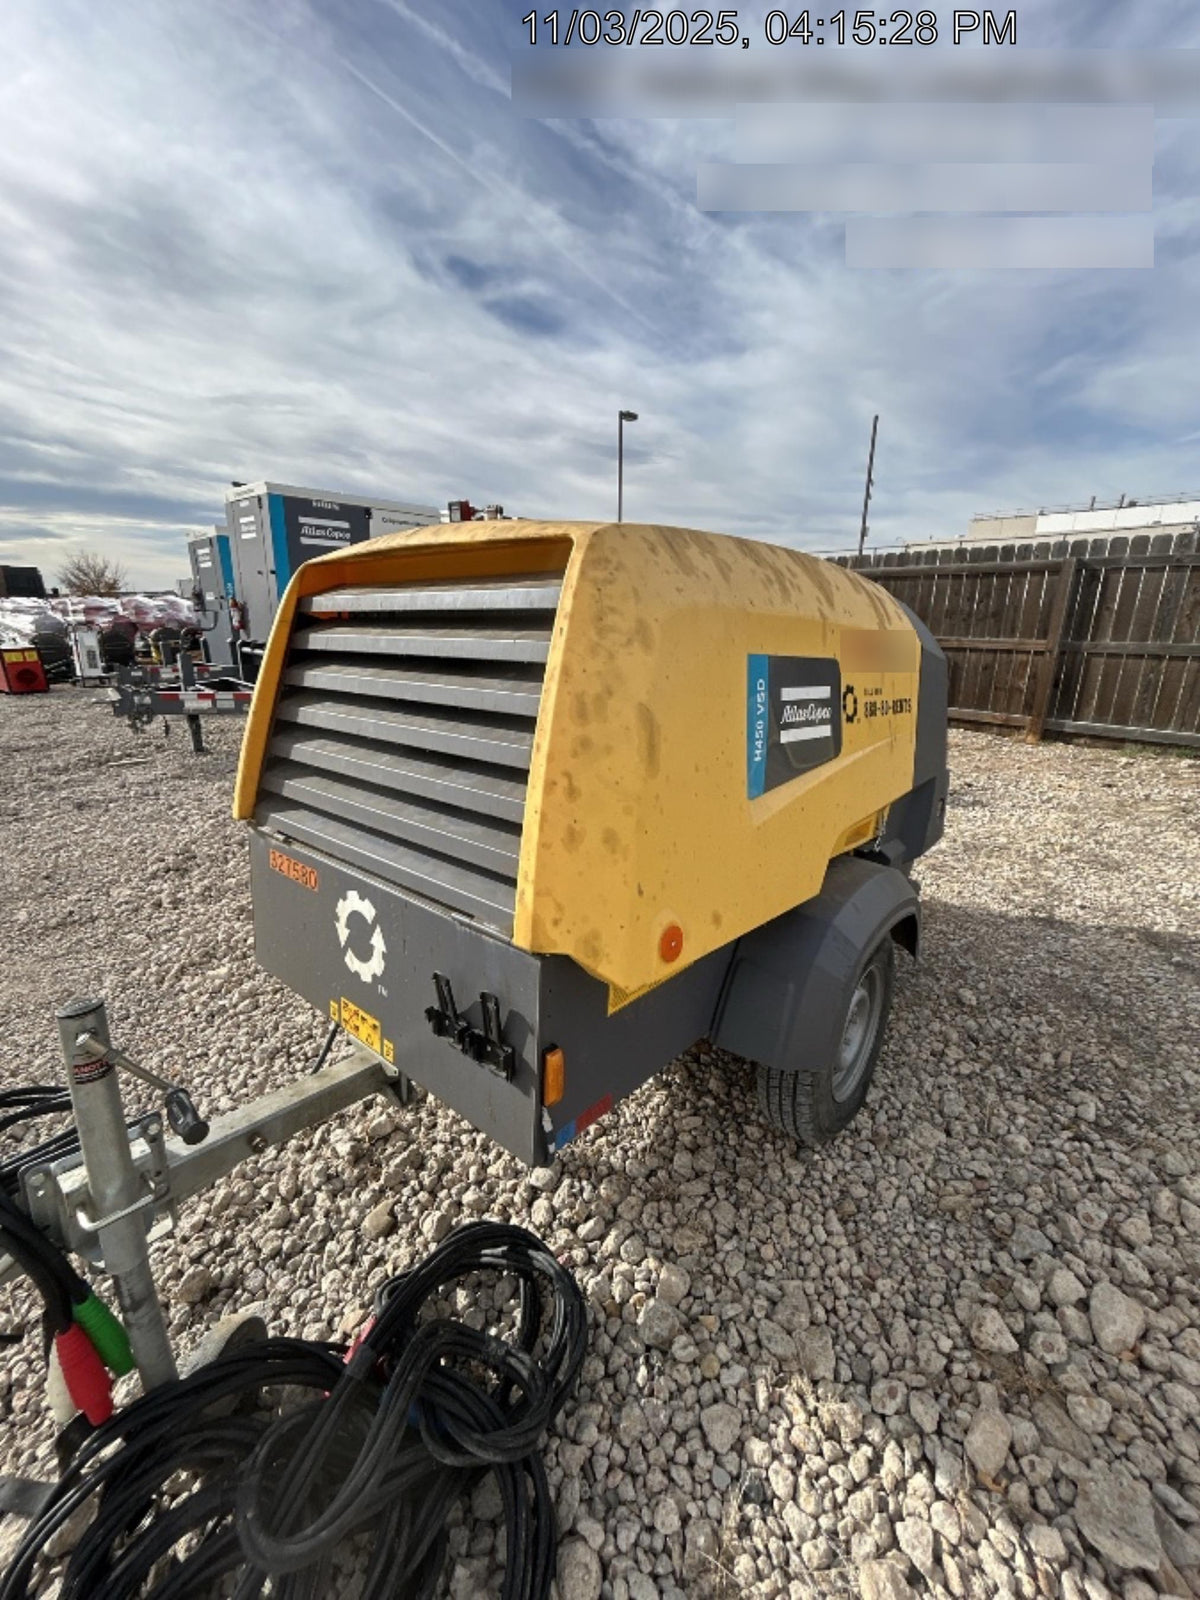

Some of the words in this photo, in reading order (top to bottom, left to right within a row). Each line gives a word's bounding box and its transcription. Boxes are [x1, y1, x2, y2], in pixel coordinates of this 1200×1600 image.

[780, 704, 807, 724] Atlas
[807, 703, 832, 724] Copco
[754, 721, 765, 762] H450
[271, 851, 318, 890] 327580
